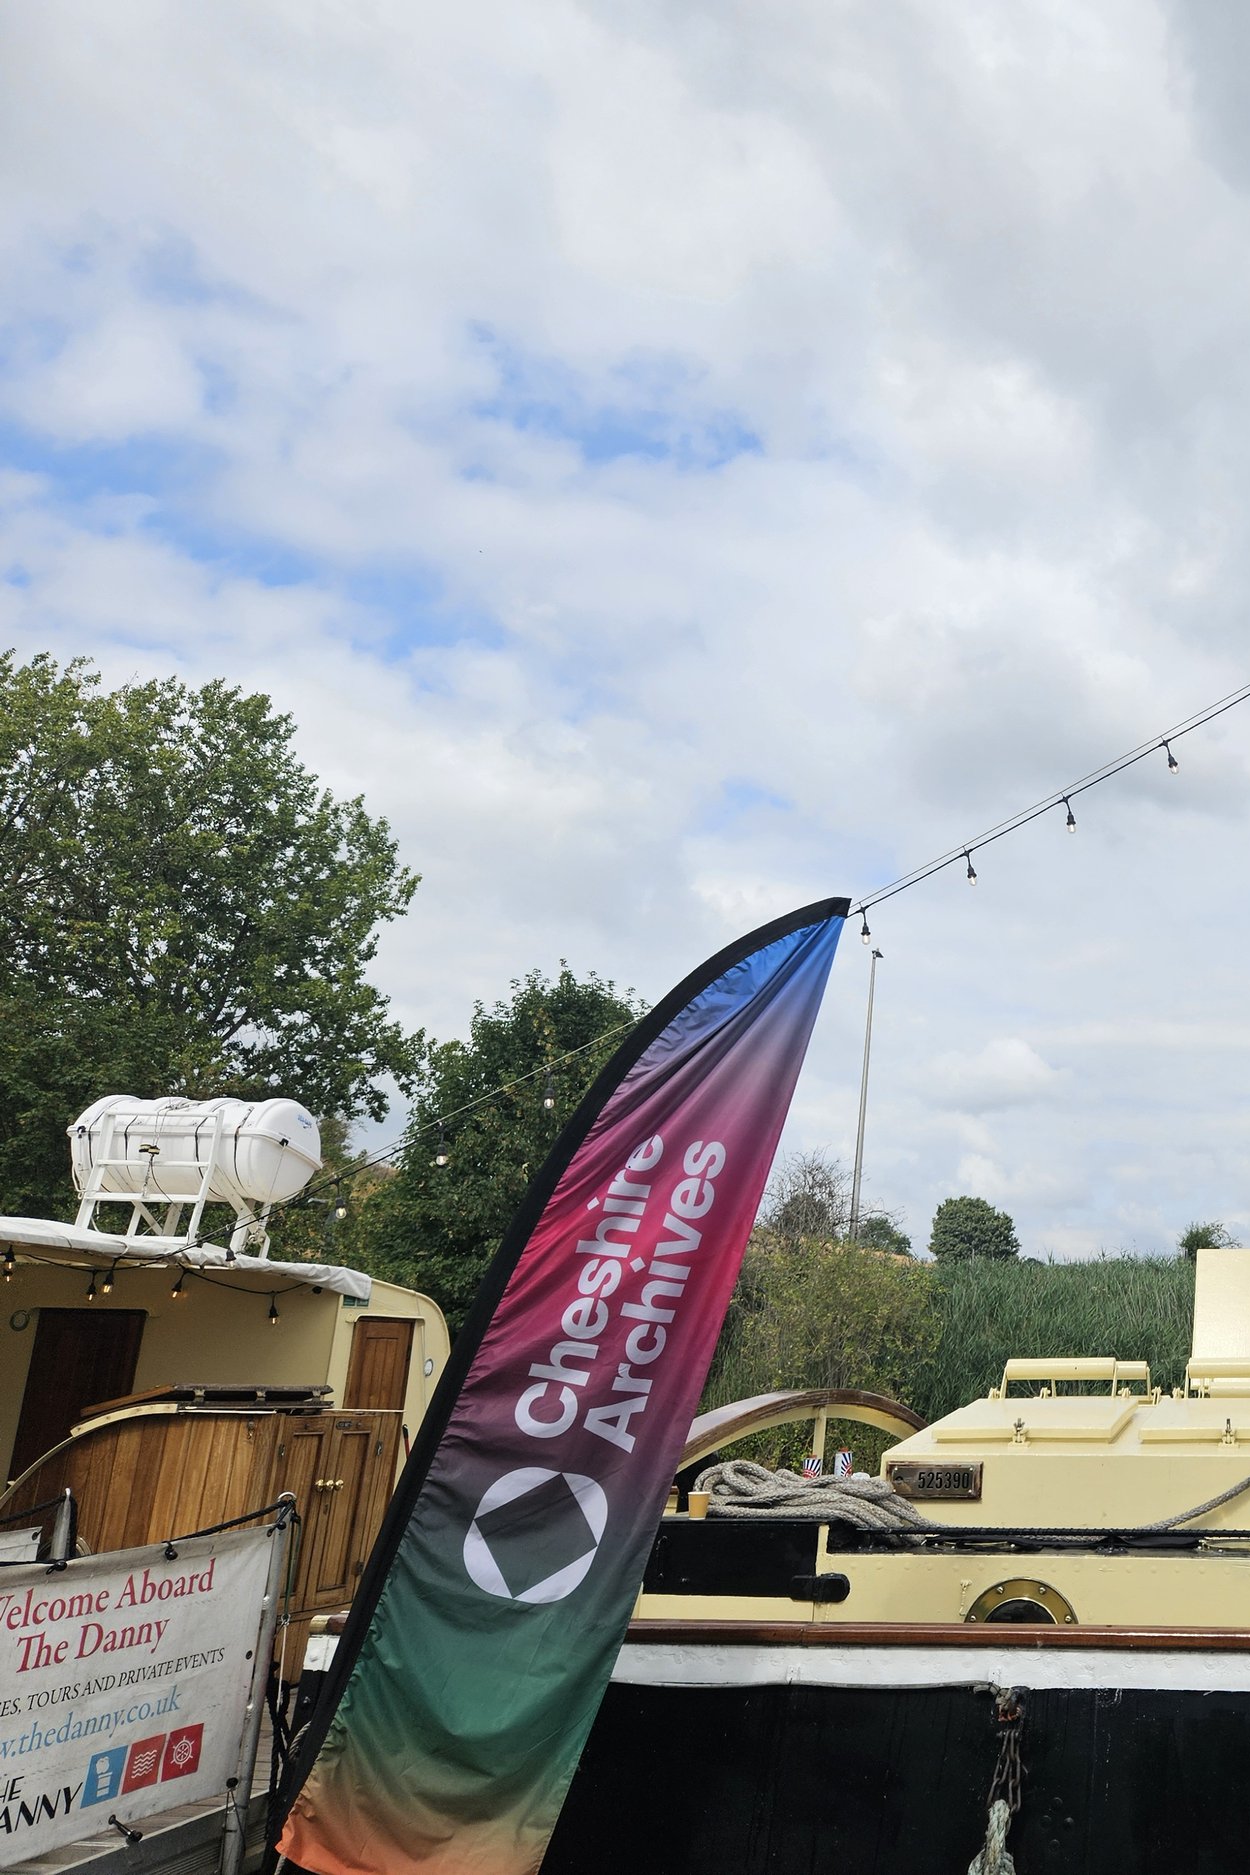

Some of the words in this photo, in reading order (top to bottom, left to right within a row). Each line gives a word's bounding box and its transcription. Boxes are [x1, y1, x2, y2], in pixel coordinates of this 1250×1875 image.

[514, 1133, 665, 1438] Cheshire
[583, 1140, 727, 1453] Archives
[918, 1472, 970, 1489] 525390
[114, 1557, 216, 1609] Aboard
[16, 1631, 69, 1673] The
[74, 1618, 171, 1660] Danny
[28, 1683, 81, 1710] TOURS
[81, 1675, 116, 1696] AND
[117, 1660, 174, 1687] PRIVATE
[174, 1647, 225, 1673] EVENTS
